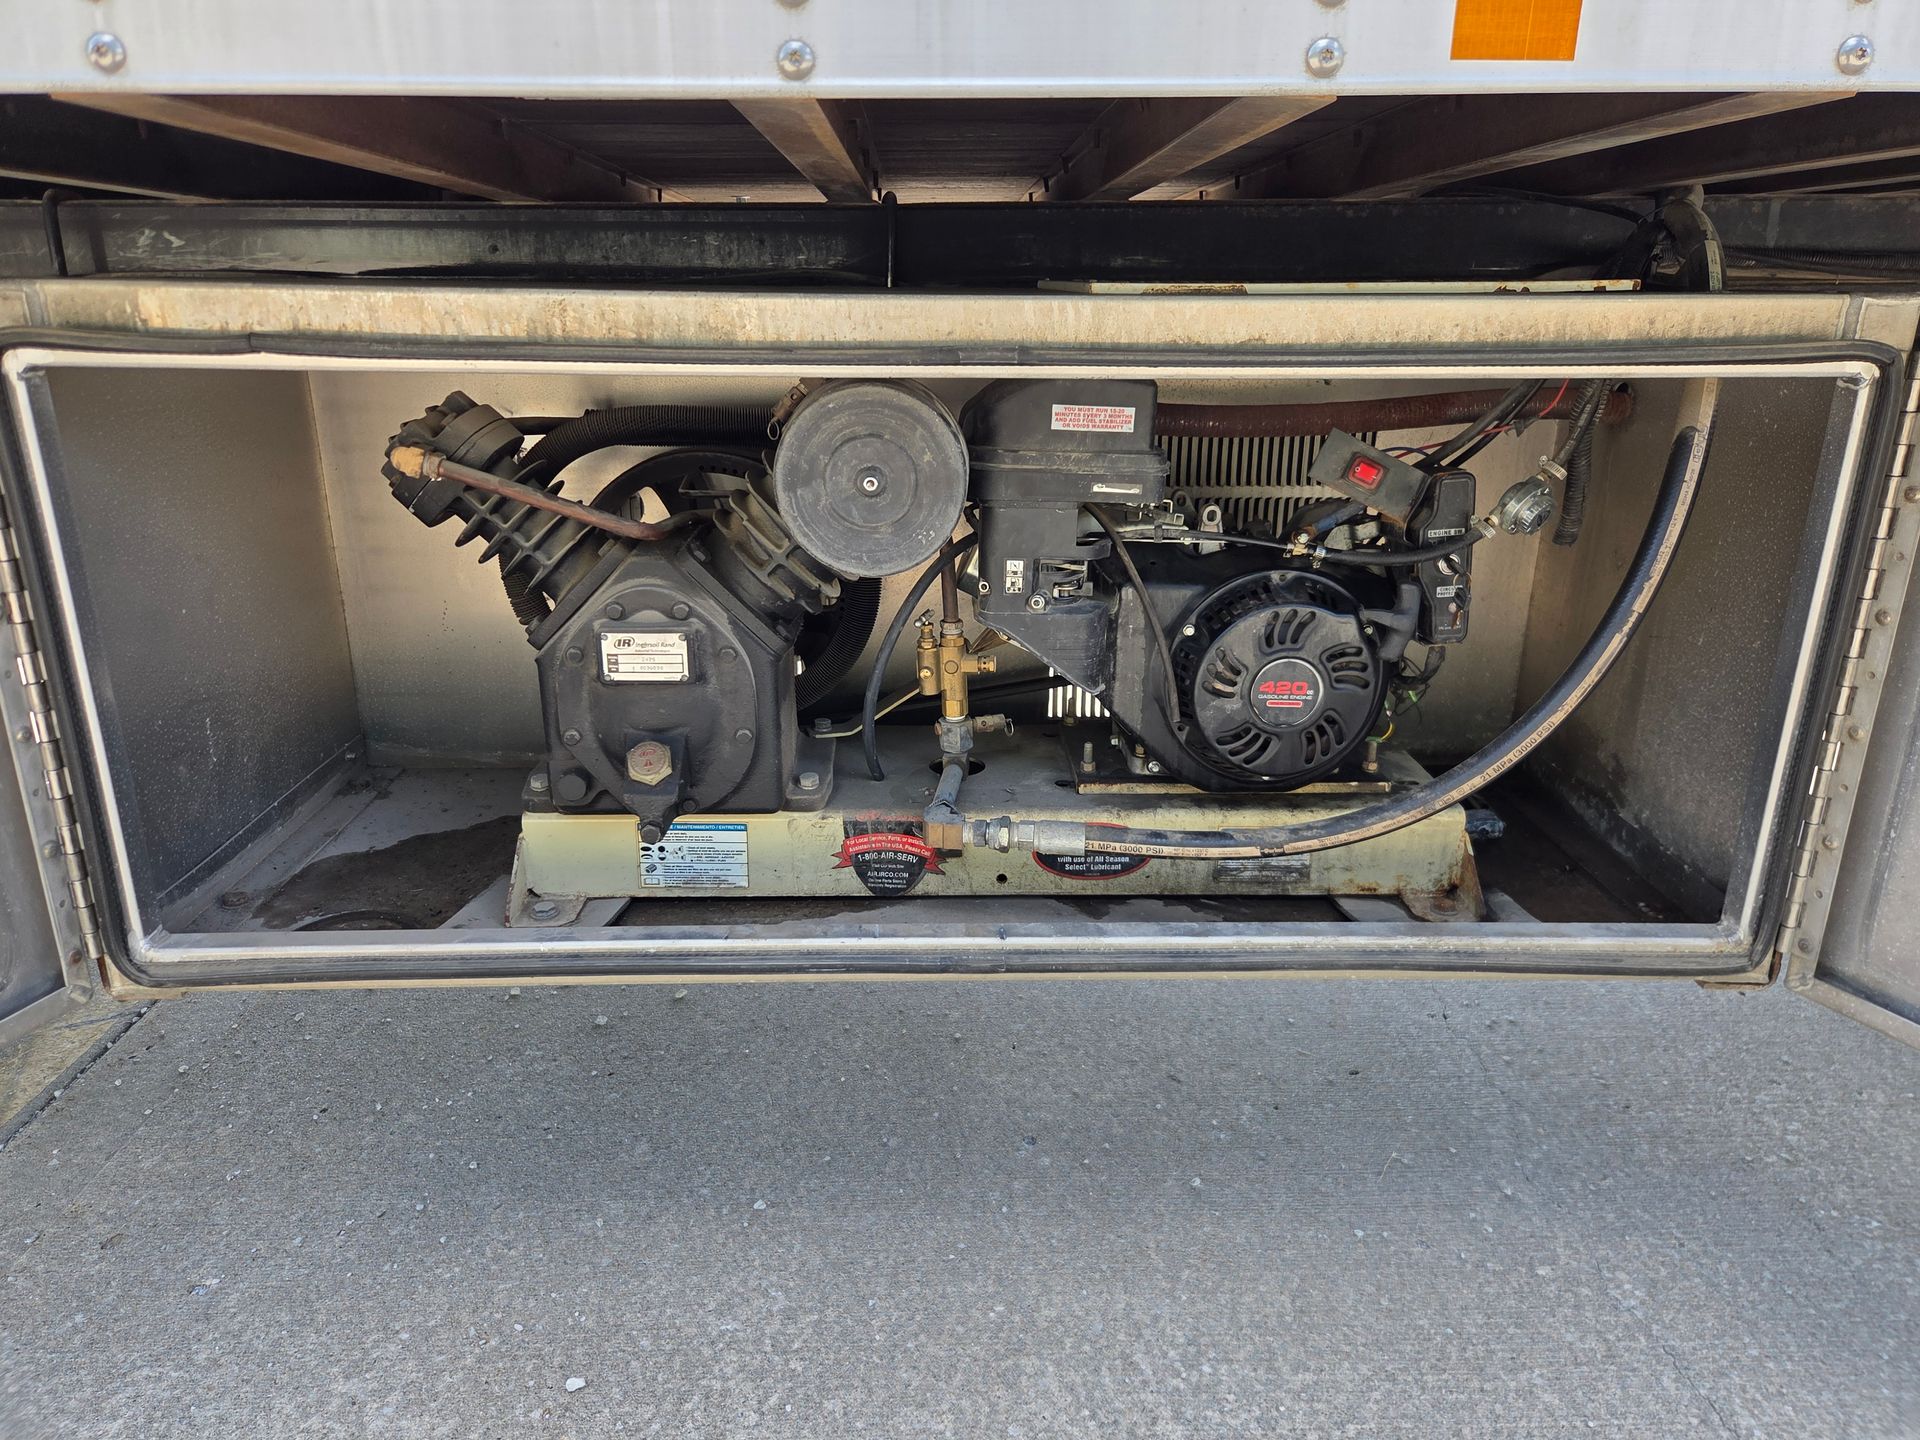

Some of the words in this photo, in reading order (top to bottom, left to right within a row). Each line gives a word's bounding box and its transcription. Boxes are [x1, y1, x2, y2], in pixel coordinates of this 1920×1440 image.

[1259, 681, 1307, 695] 420
[1480, 772, 1491, 781] 21
[1493, 758, 1513, 774] MPa
[1513, 738, 1537, 758] (3000
[1536, 720, 1556, 738] PSI)
[905, 844, 920, 853] Please
[1120, 844, 1143, 853] (3000
[858, 852, 918, 863] 1-800-AIR-SERV
